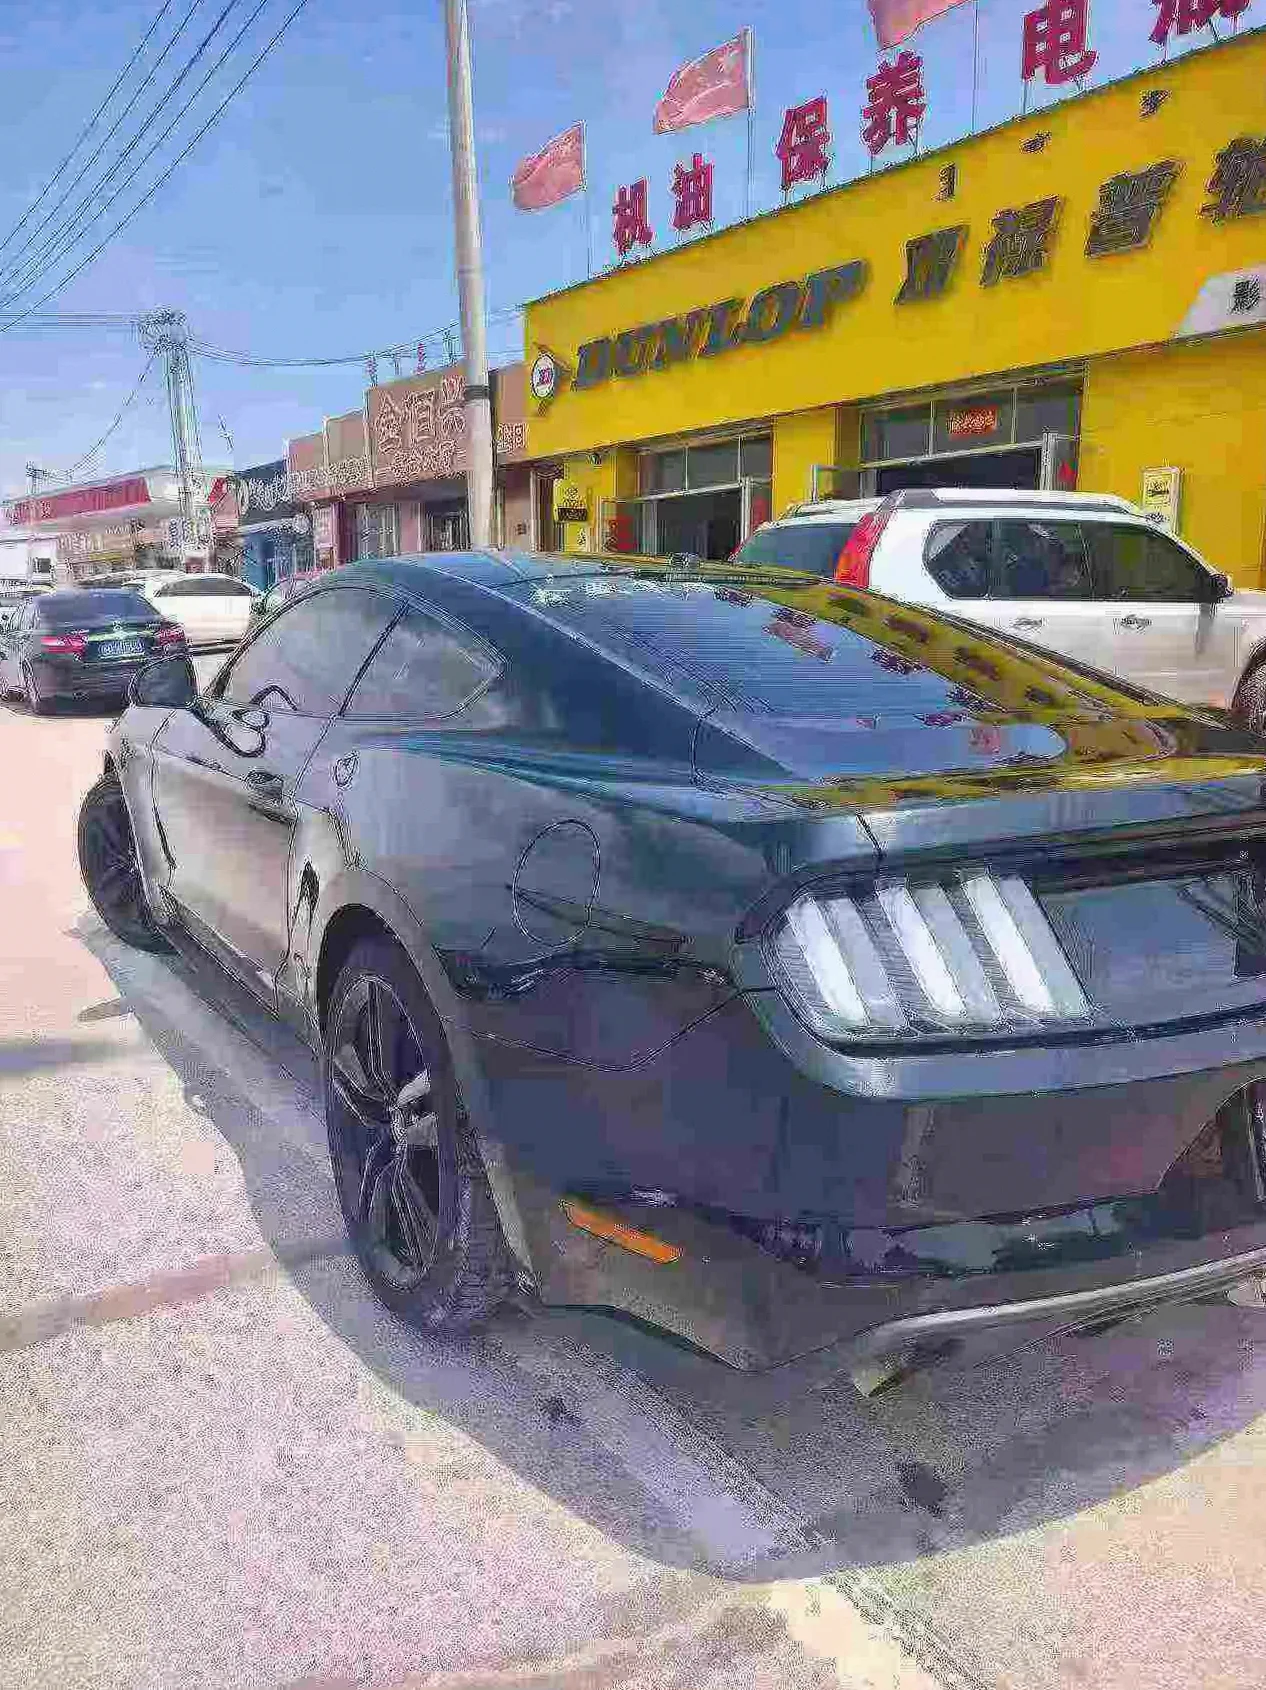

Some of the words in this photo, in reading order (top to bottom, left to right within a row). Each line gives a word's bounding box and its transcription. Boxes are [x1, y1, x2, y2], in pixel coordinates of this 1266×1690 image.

[612, 153, 713, 253] 机油
[777, 51, 925, 184] 保养
[571, 259, 868, 391] DUNLOP
